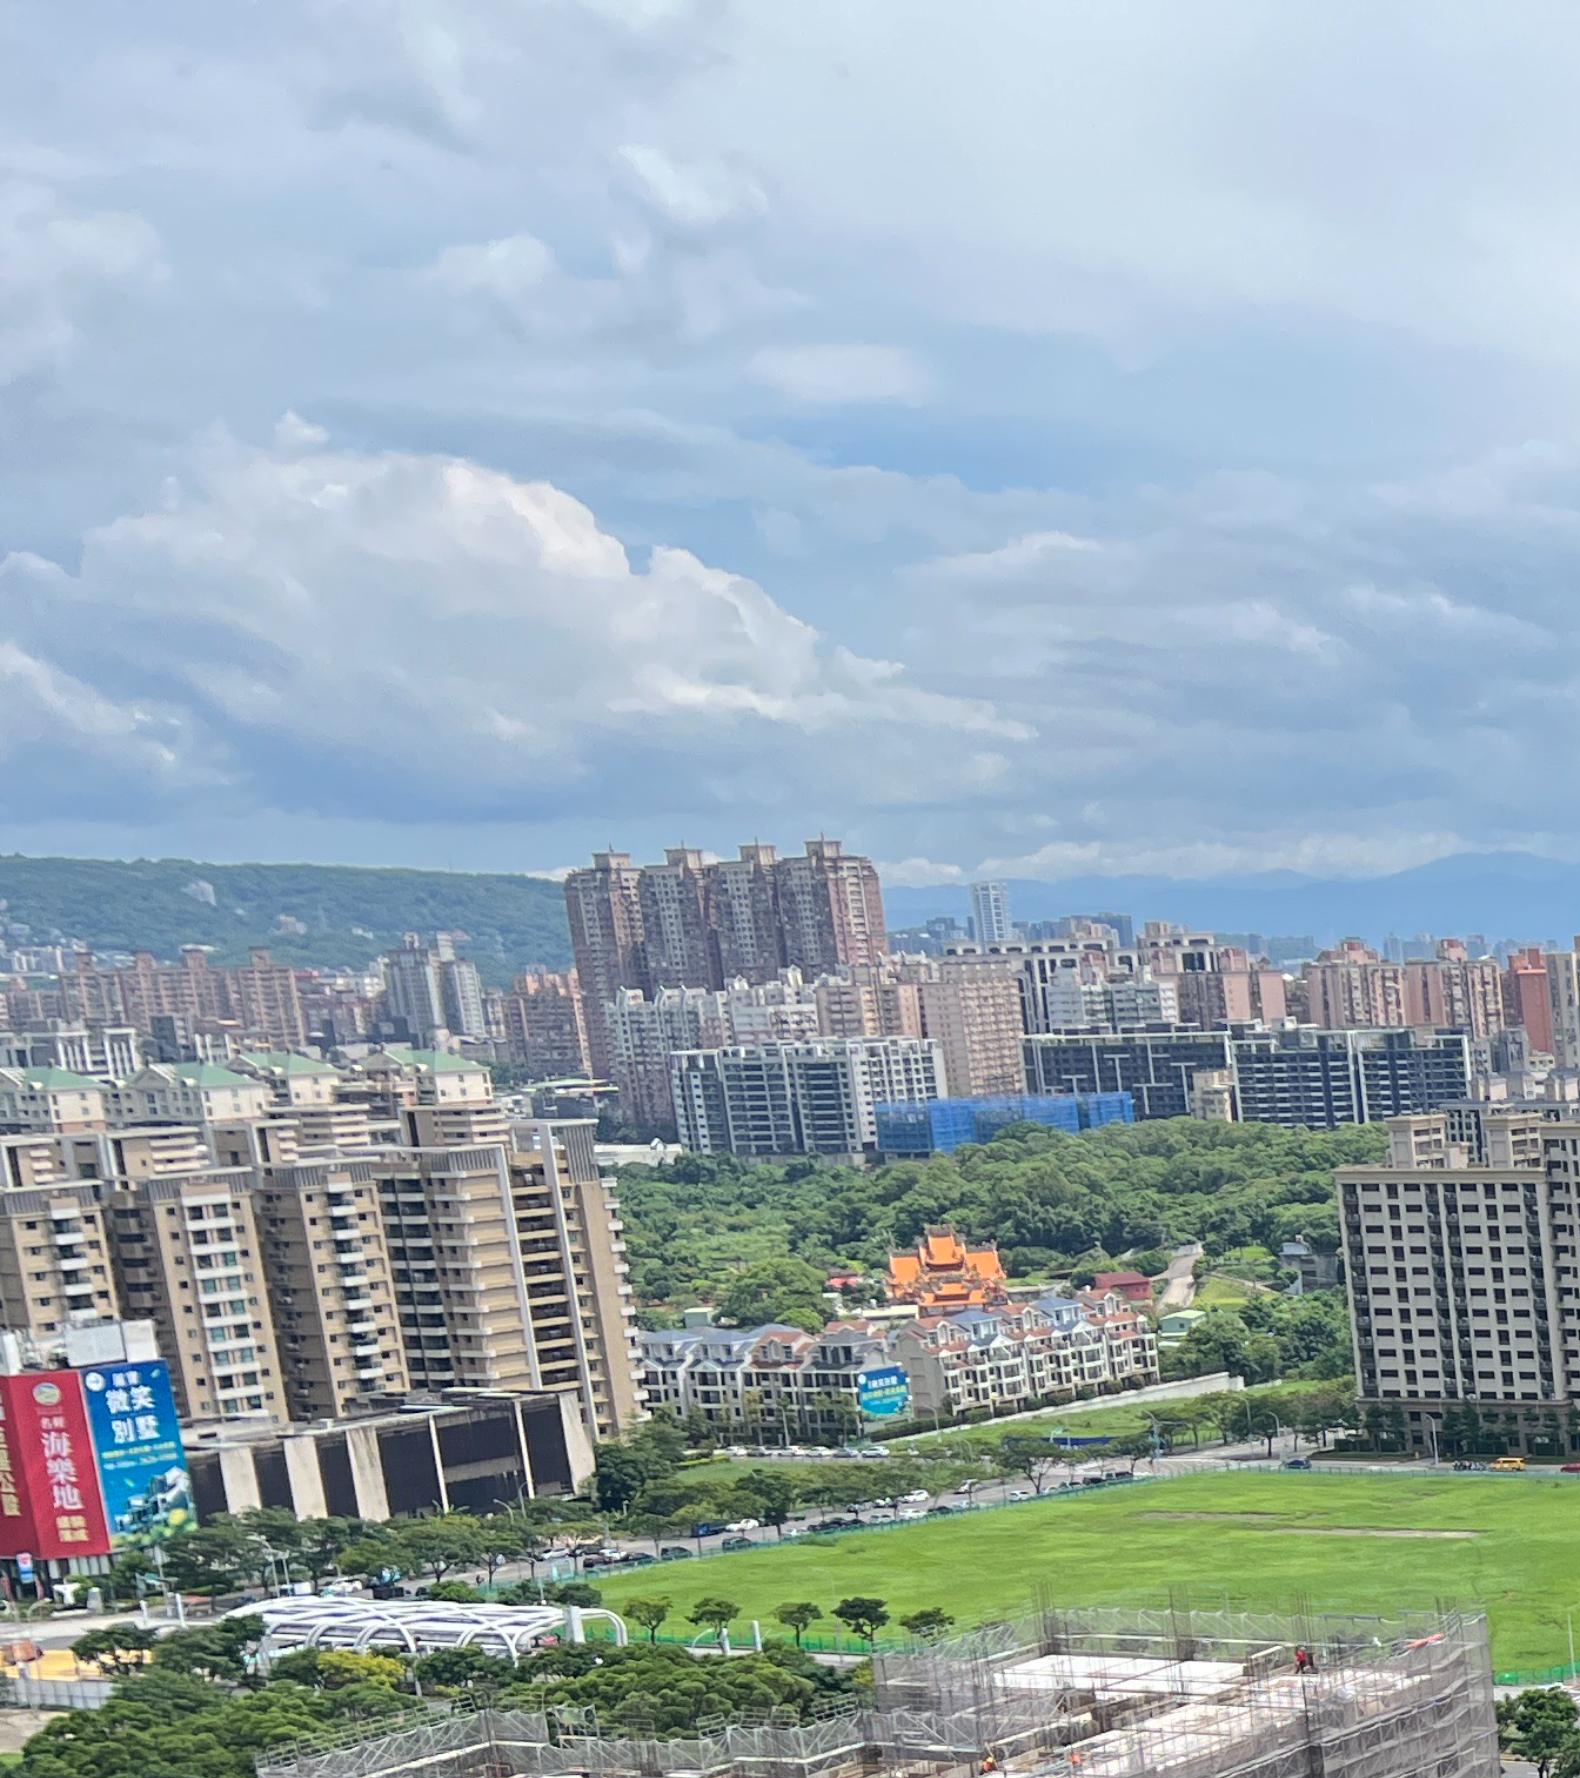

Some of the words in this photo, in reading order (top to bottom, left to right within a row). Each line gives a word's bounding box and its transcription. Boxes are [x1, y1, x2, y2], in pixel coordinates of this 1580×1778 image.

[105, 1385, 156, 1414] 微笑
[111, 1414, 161, 1444] 別墅
[40, 1431, 86, 1510] 海樂地
